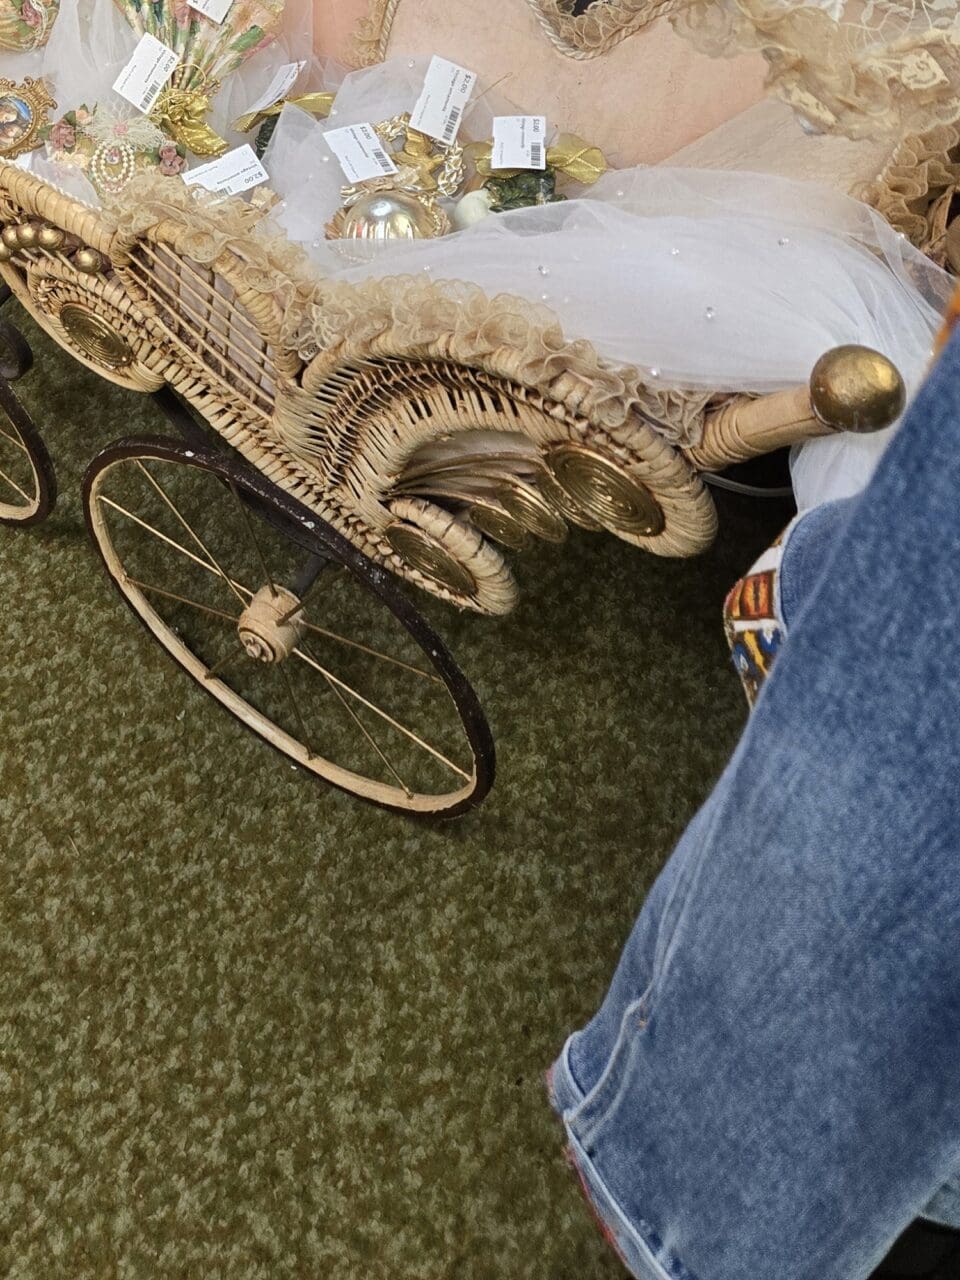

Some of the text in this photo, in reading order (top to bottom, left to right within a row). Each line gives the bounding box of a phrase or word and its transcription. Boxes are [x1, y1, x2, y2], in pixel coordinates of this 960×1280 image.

[163, 55, 176, 73] $2.00
[460, 74, 472, 94] $2.00
[244, 171, 263, 184] $2.00
